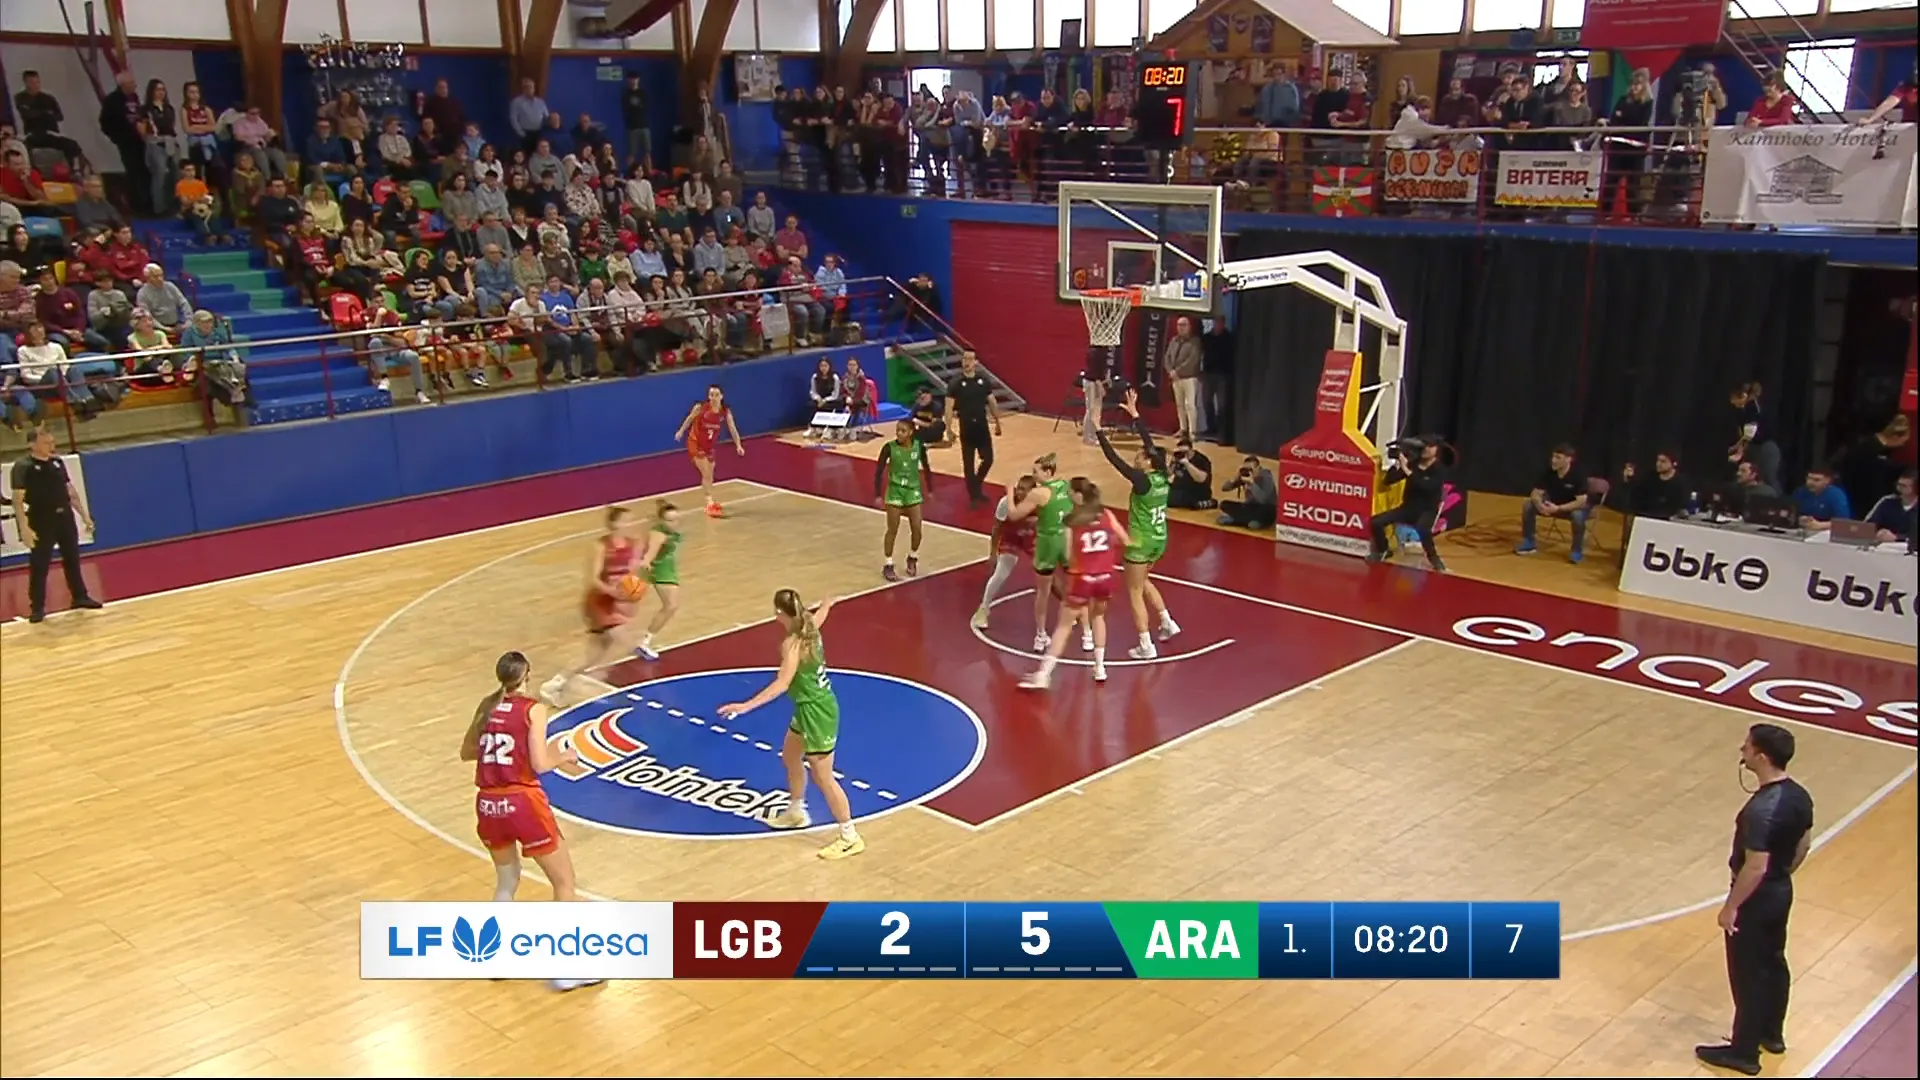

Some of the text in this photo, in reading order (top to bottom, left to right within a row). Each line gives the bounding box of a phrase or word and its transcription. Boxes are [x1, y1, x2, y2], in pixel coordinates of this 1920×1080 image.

[1144, 66, 1184, 85] 08:20
[1166, 98, 1182, 136] 7
[1829, 129, 1899, 147] Hotea
[1388, 150, 1480, 177] AUPA
[1506, 169, 1589, 186] BATERA
[1308, 479, 1368, 499] HYUNDAI
[1149, 504, 1167, 525] 15
[1081, 530, 1110, 553] 12
[1643, 542, 1729, 584] bbk
[1807, 569, 1907, 615] bbk
[479, 733, 516, 765] 22
